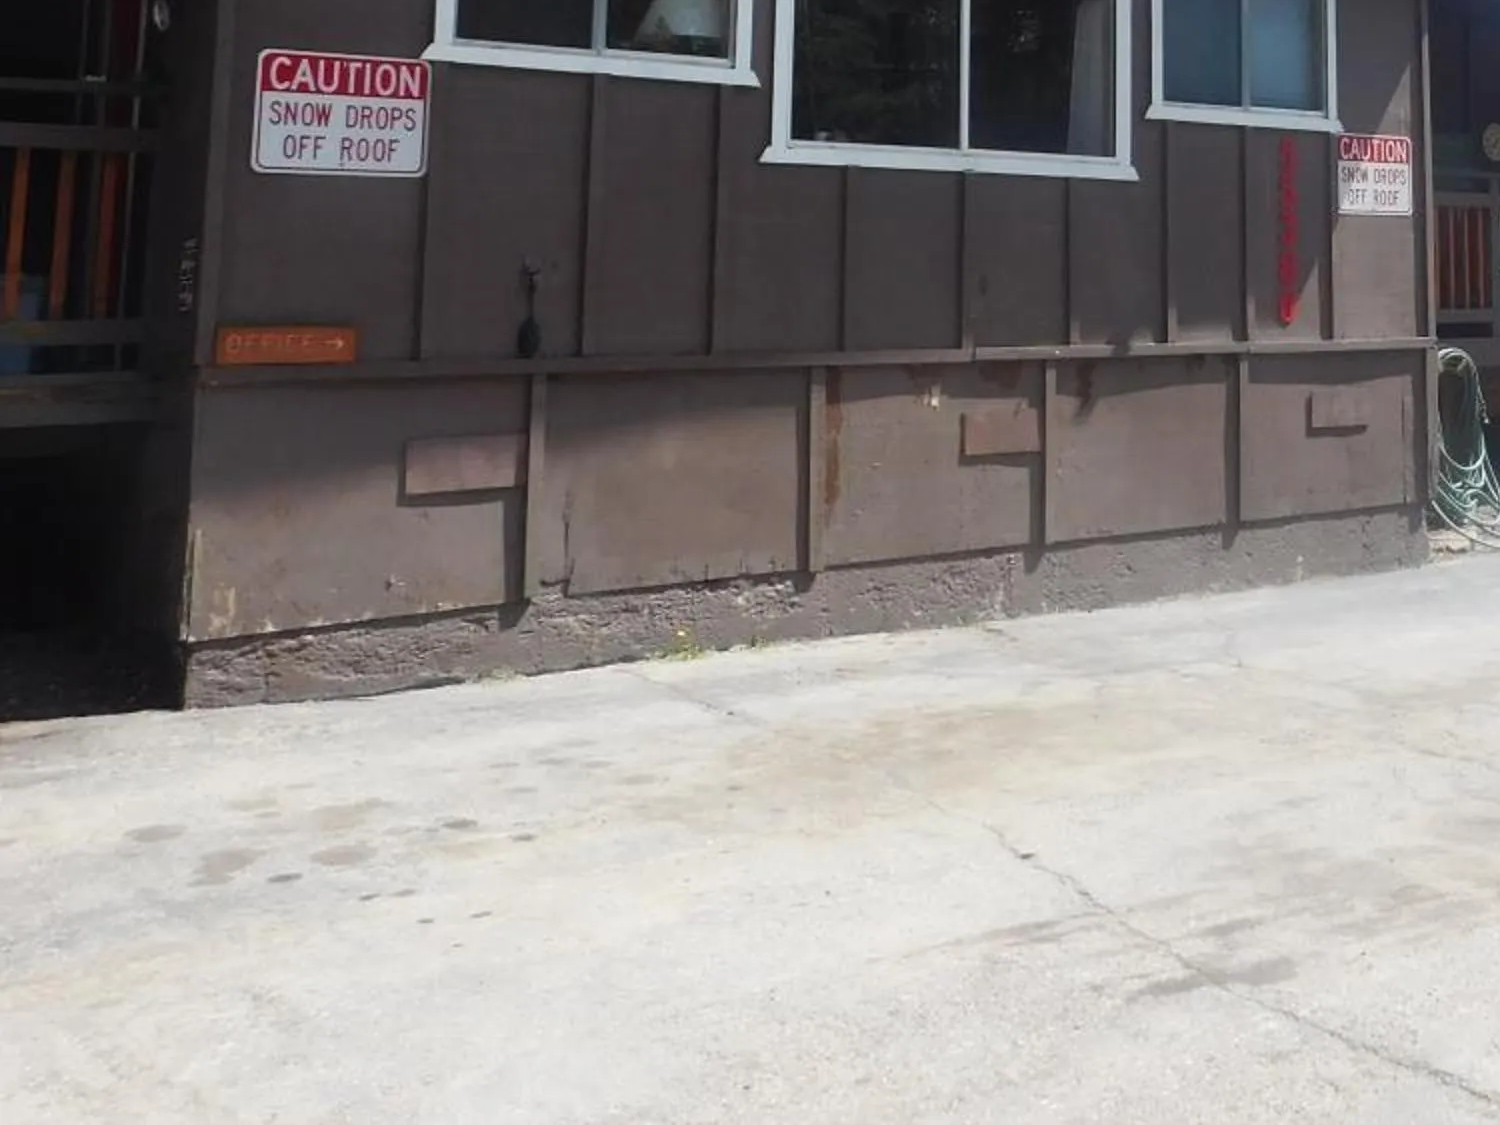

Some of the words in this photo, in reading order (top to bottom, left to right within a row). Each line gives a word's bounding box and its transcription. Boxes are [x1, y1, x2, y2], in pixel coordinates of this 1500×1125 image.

[270, 56, 421, 97] CAUTION
[269, 100, 333, 127] SNOW
[345, 105, 417, 131] DROPS
[283, 134, 326, 160] OFF
[340, 136, 400, 162] ROOF
[1340, 137, 1407, 163] CAUTION
[1341, 166, 1368, 183] SNOW
[1374, 168, 1406, 186] DROPS
[1373, 189, 1400, 205] ROOF
